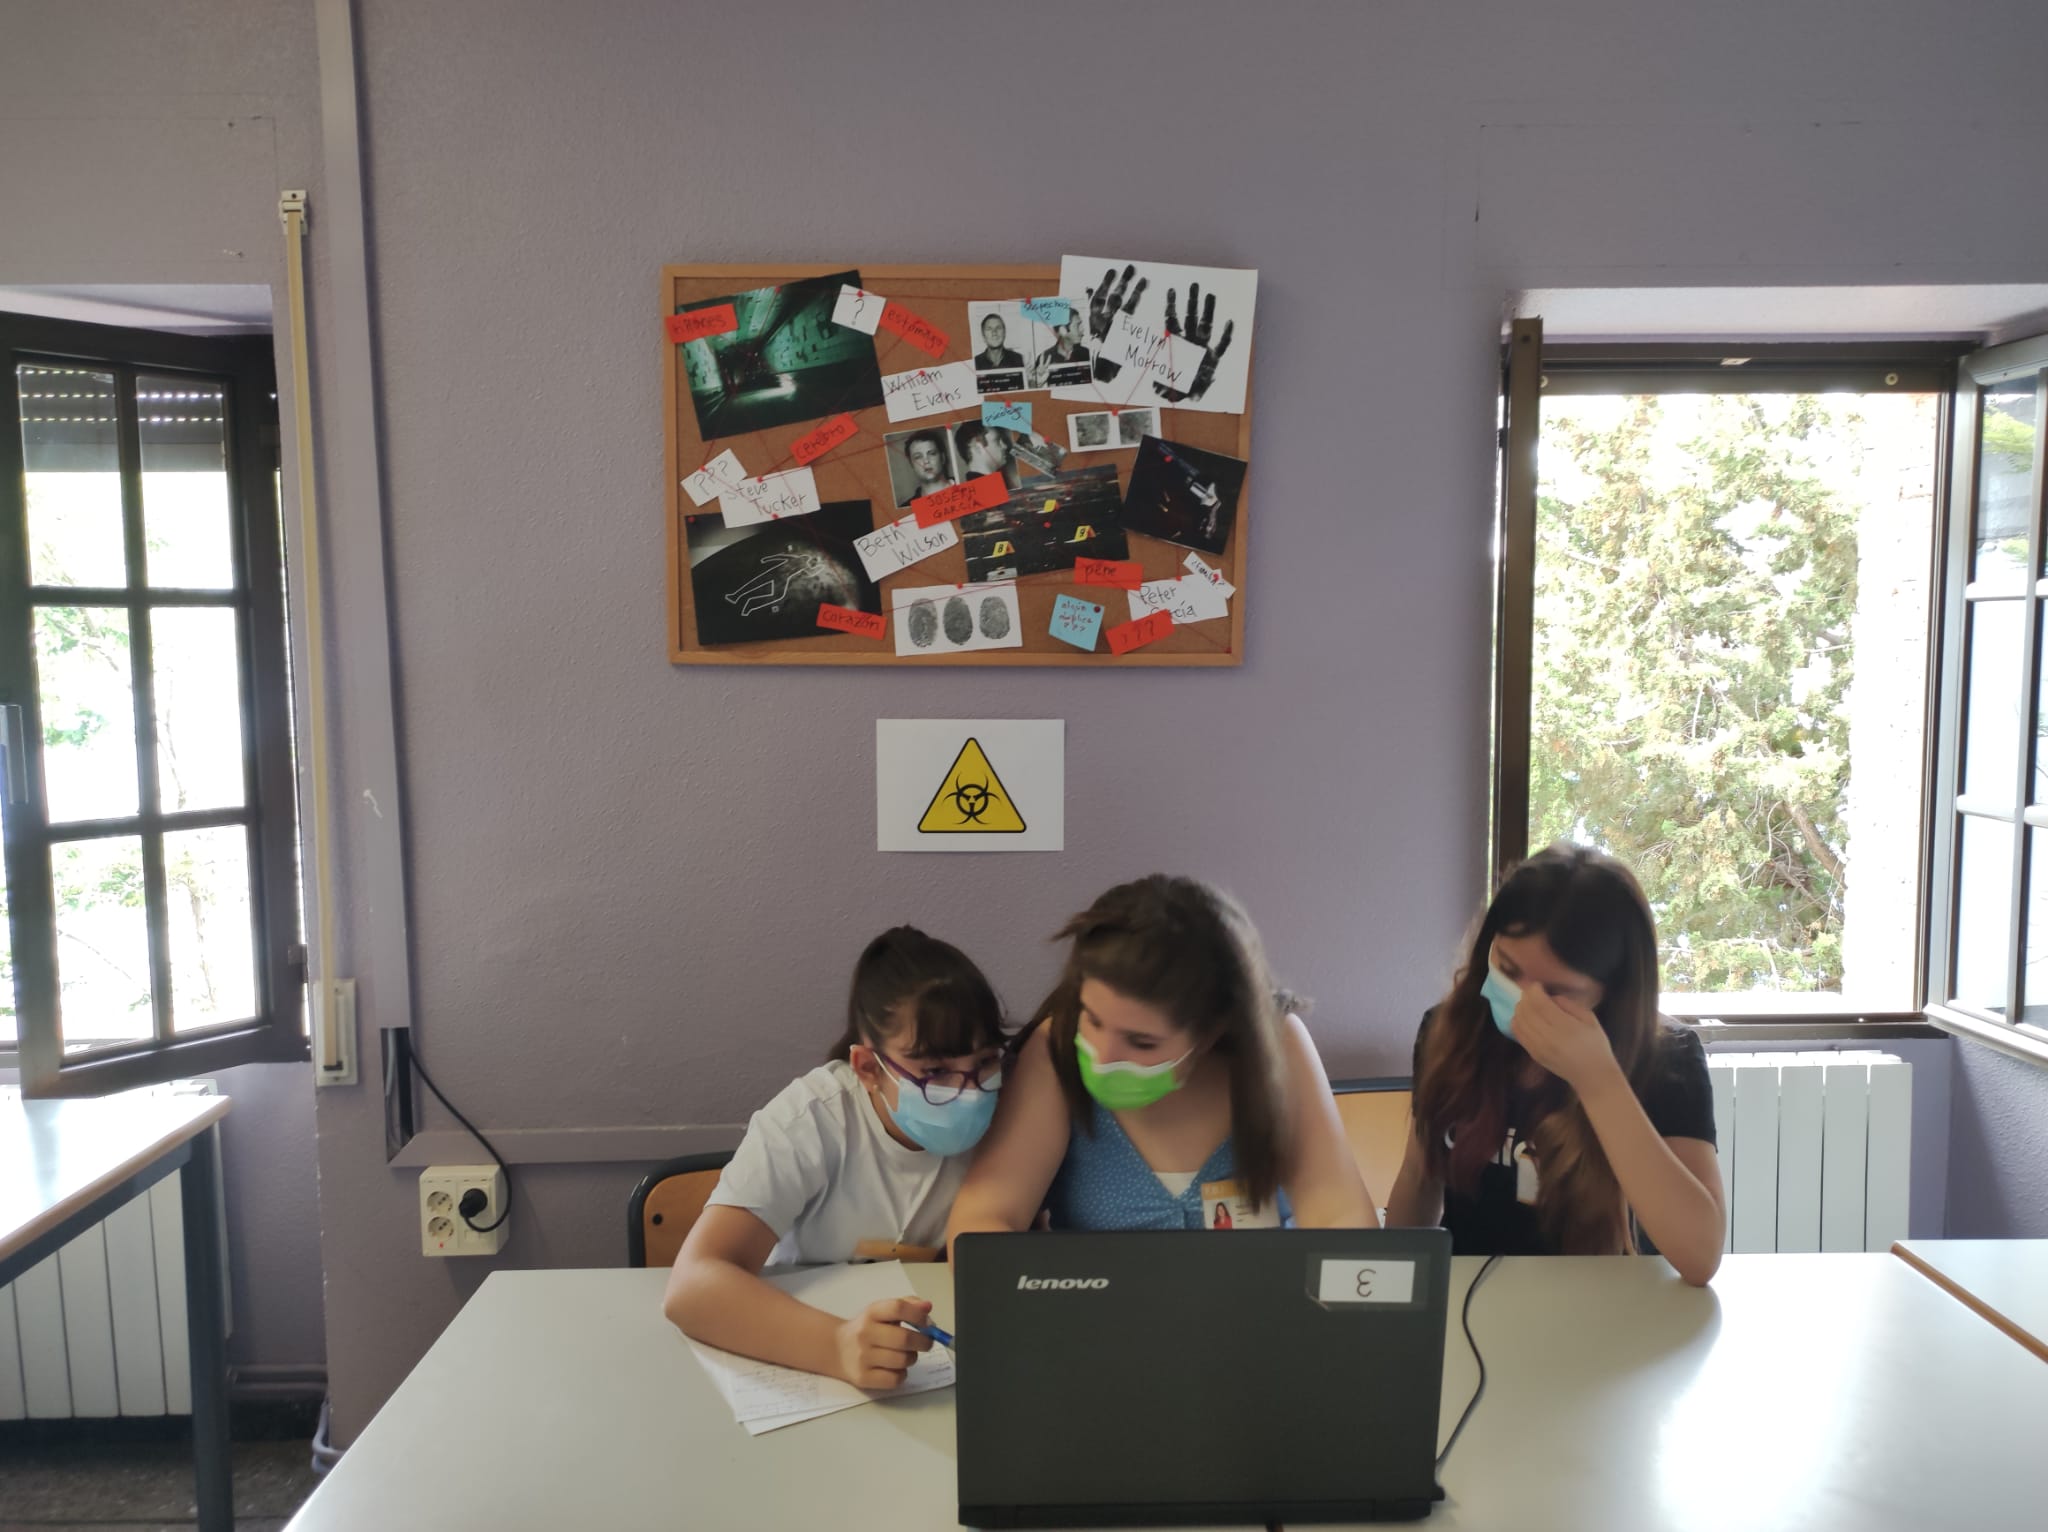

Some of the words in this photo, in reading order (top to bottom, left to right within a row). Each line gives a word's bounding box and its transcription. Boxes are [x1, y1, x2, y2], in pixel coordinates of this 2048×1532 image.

[1121, 315, 1166, 353] Evelyn
[1125, 345, 1182, 382] Morrow
[884, 370, 944, 395] William
[912, 387, 962, 411] Evans
[750, 493, 807, 516] Tucker
[857, 526, 906, 557] Beth
[896, 530, 948, 566] Wilson
[1140, 585, 1178, 606] Peter
[1017, 1275, 1109, 1291] lenovo
